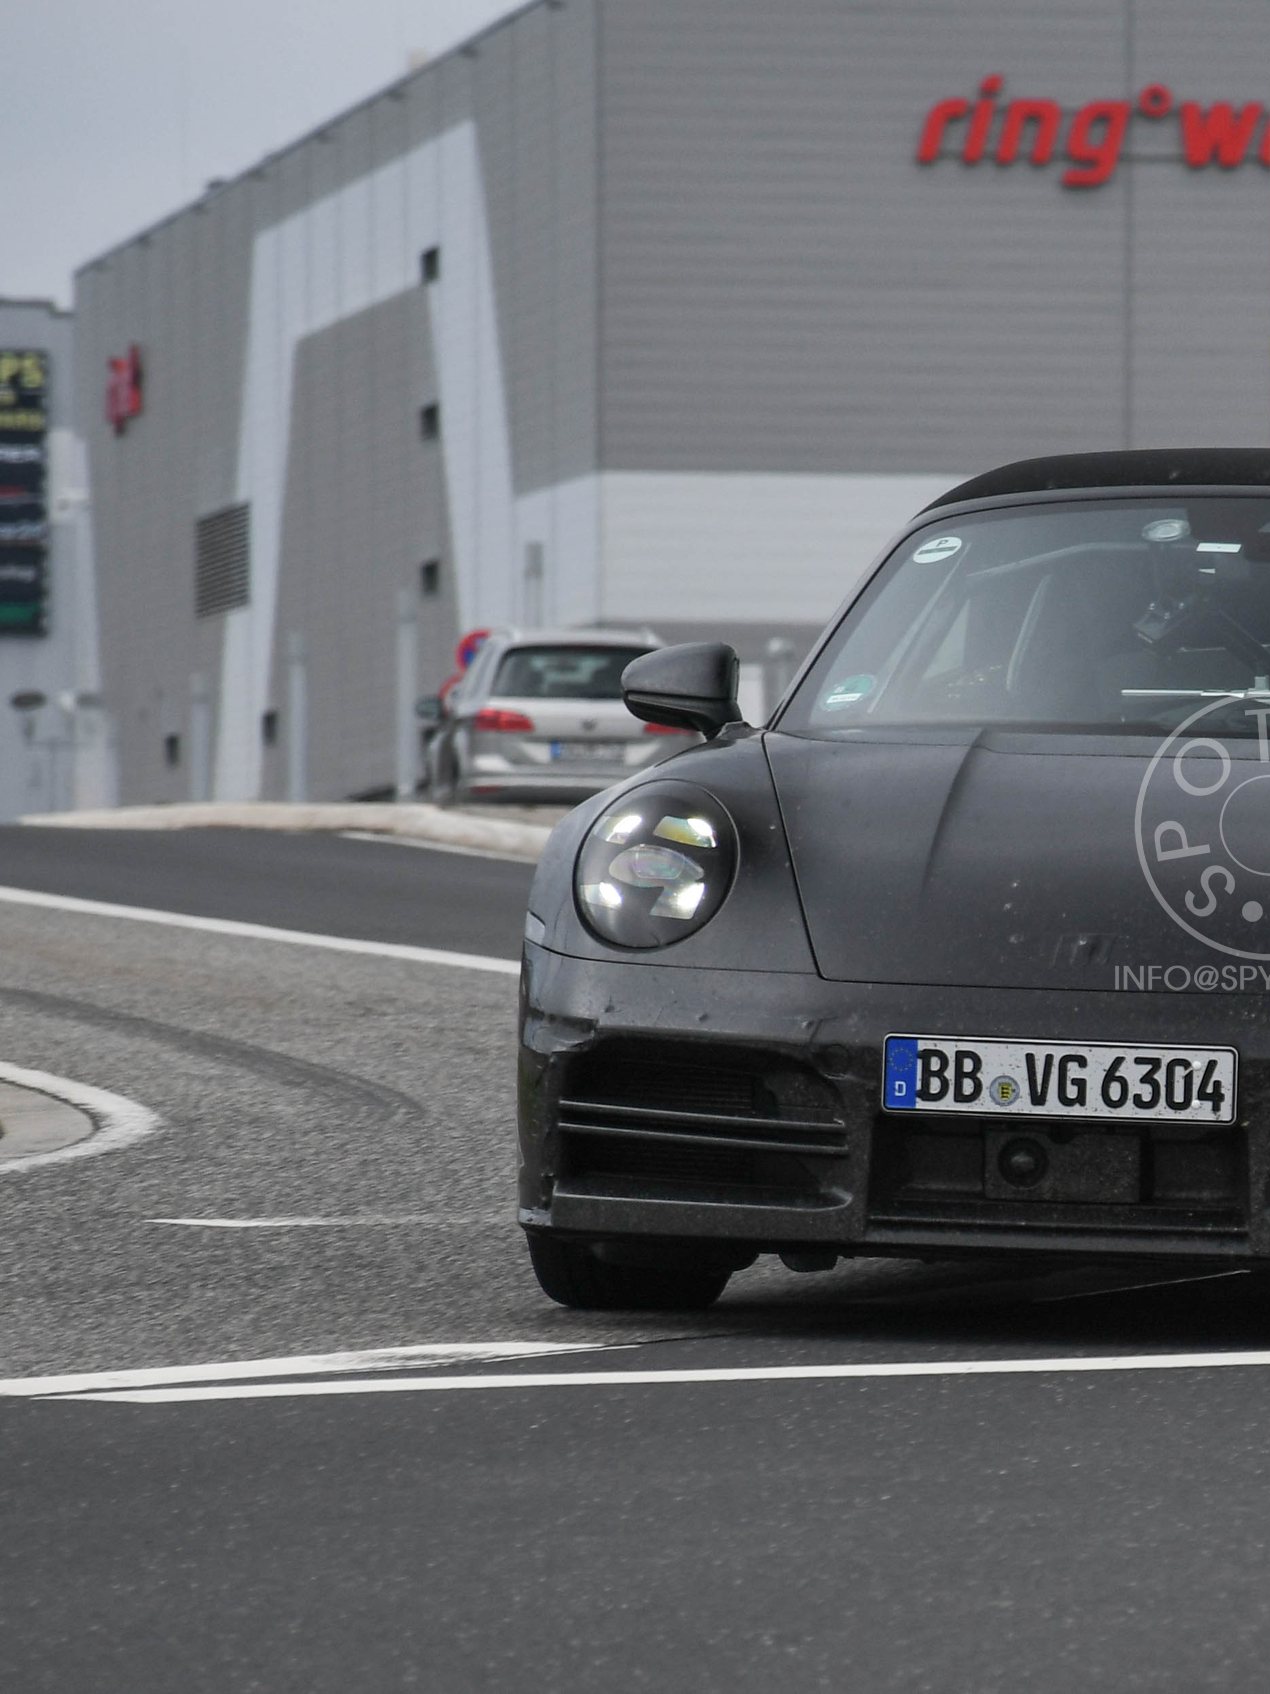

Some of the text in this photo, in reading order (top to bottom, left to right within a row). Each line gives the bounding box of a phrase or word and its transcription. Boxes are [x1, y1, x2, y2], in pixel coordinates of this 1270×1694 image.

[895, 1081, 906, 1096] D
[917, 1049, 1226, 1112] BB VG 6304
